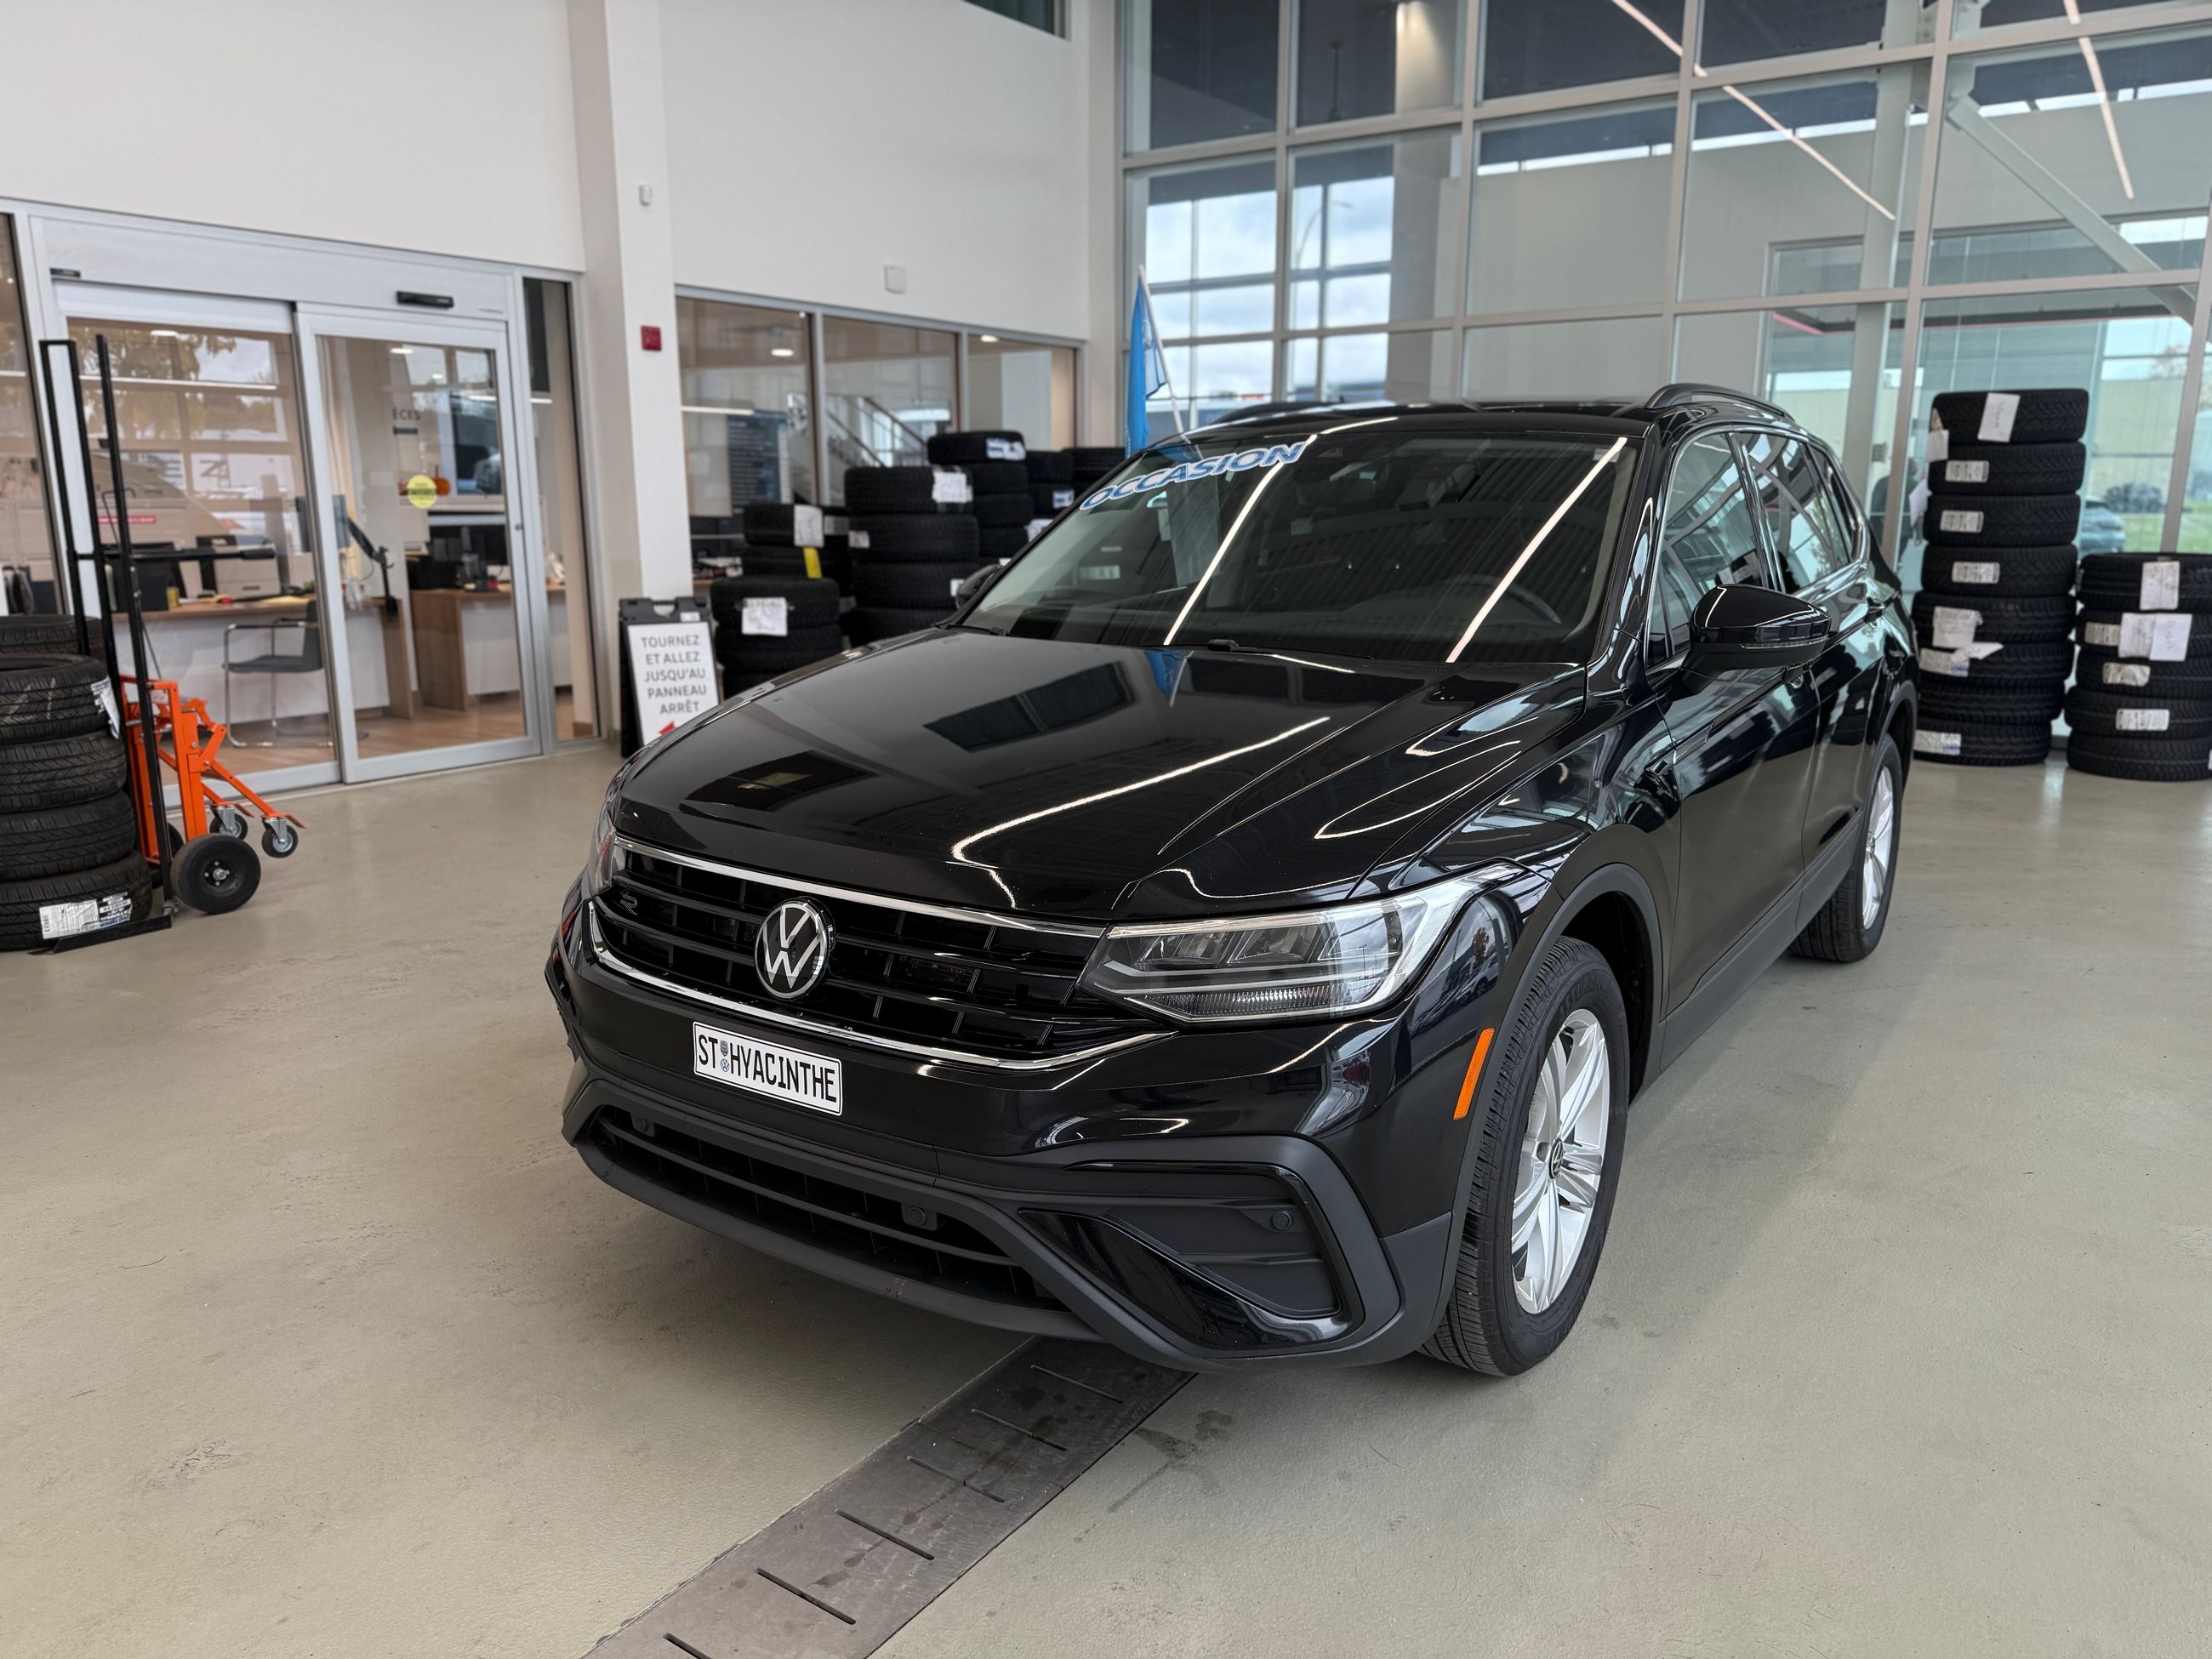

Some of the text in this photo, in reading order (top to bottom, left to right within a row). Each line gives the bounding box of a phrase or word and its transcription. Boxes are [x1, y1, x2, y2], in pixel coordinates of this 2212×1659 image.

[1080, 442, 1308, 510] OCCASION
[641, 635, 700, 648] TOURNEZ
[646, 652, 700, 665] ET ALLEZ
[645, 668, 706, 682] JUSQU'AU
[647, 685, 707, 698] PANNEAU
[659, 700, 700, 715] ARRÊT
[698, 1035, 837, 1103] ST HYACINTHE
